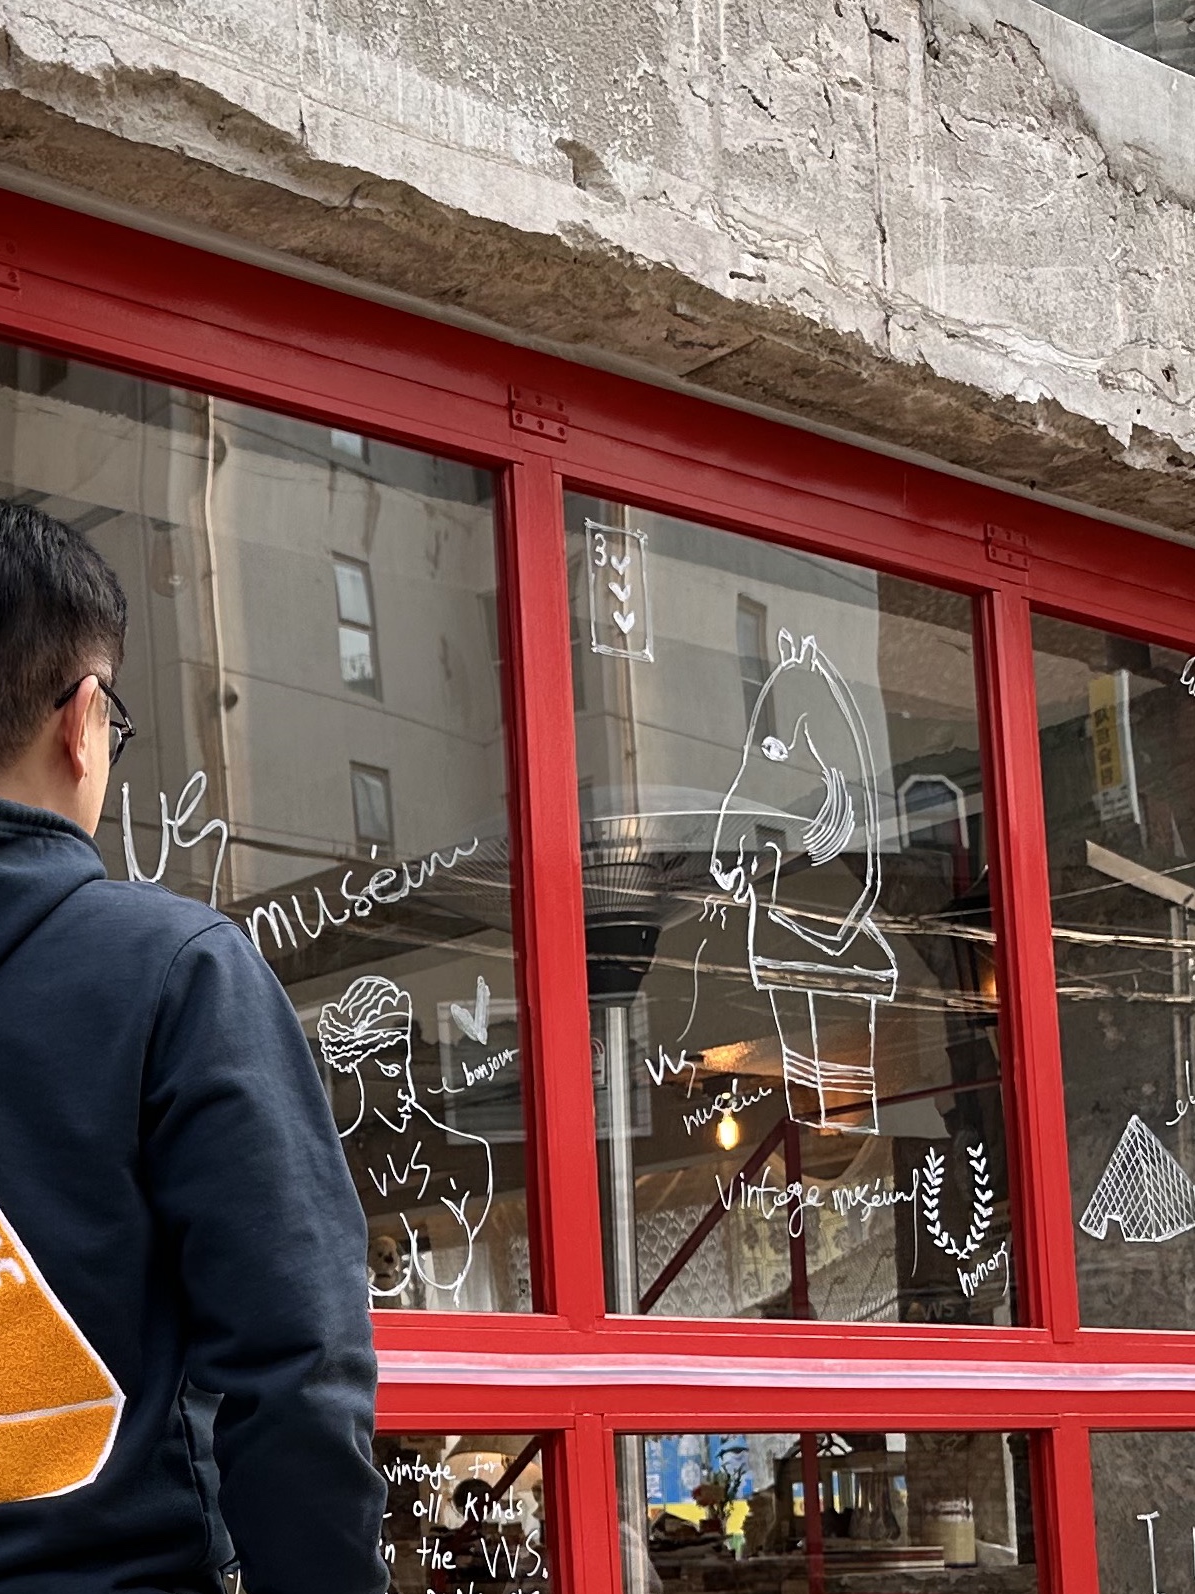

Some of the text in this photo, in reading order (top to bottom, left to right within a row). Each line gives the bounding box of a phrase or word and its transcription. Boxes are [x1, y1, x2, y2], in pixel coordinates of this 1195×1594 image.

[383, 1454, 456, 1490] vintage
[413, 1493, 443, 1524] all
[416, 1537, 456, 1569] the
